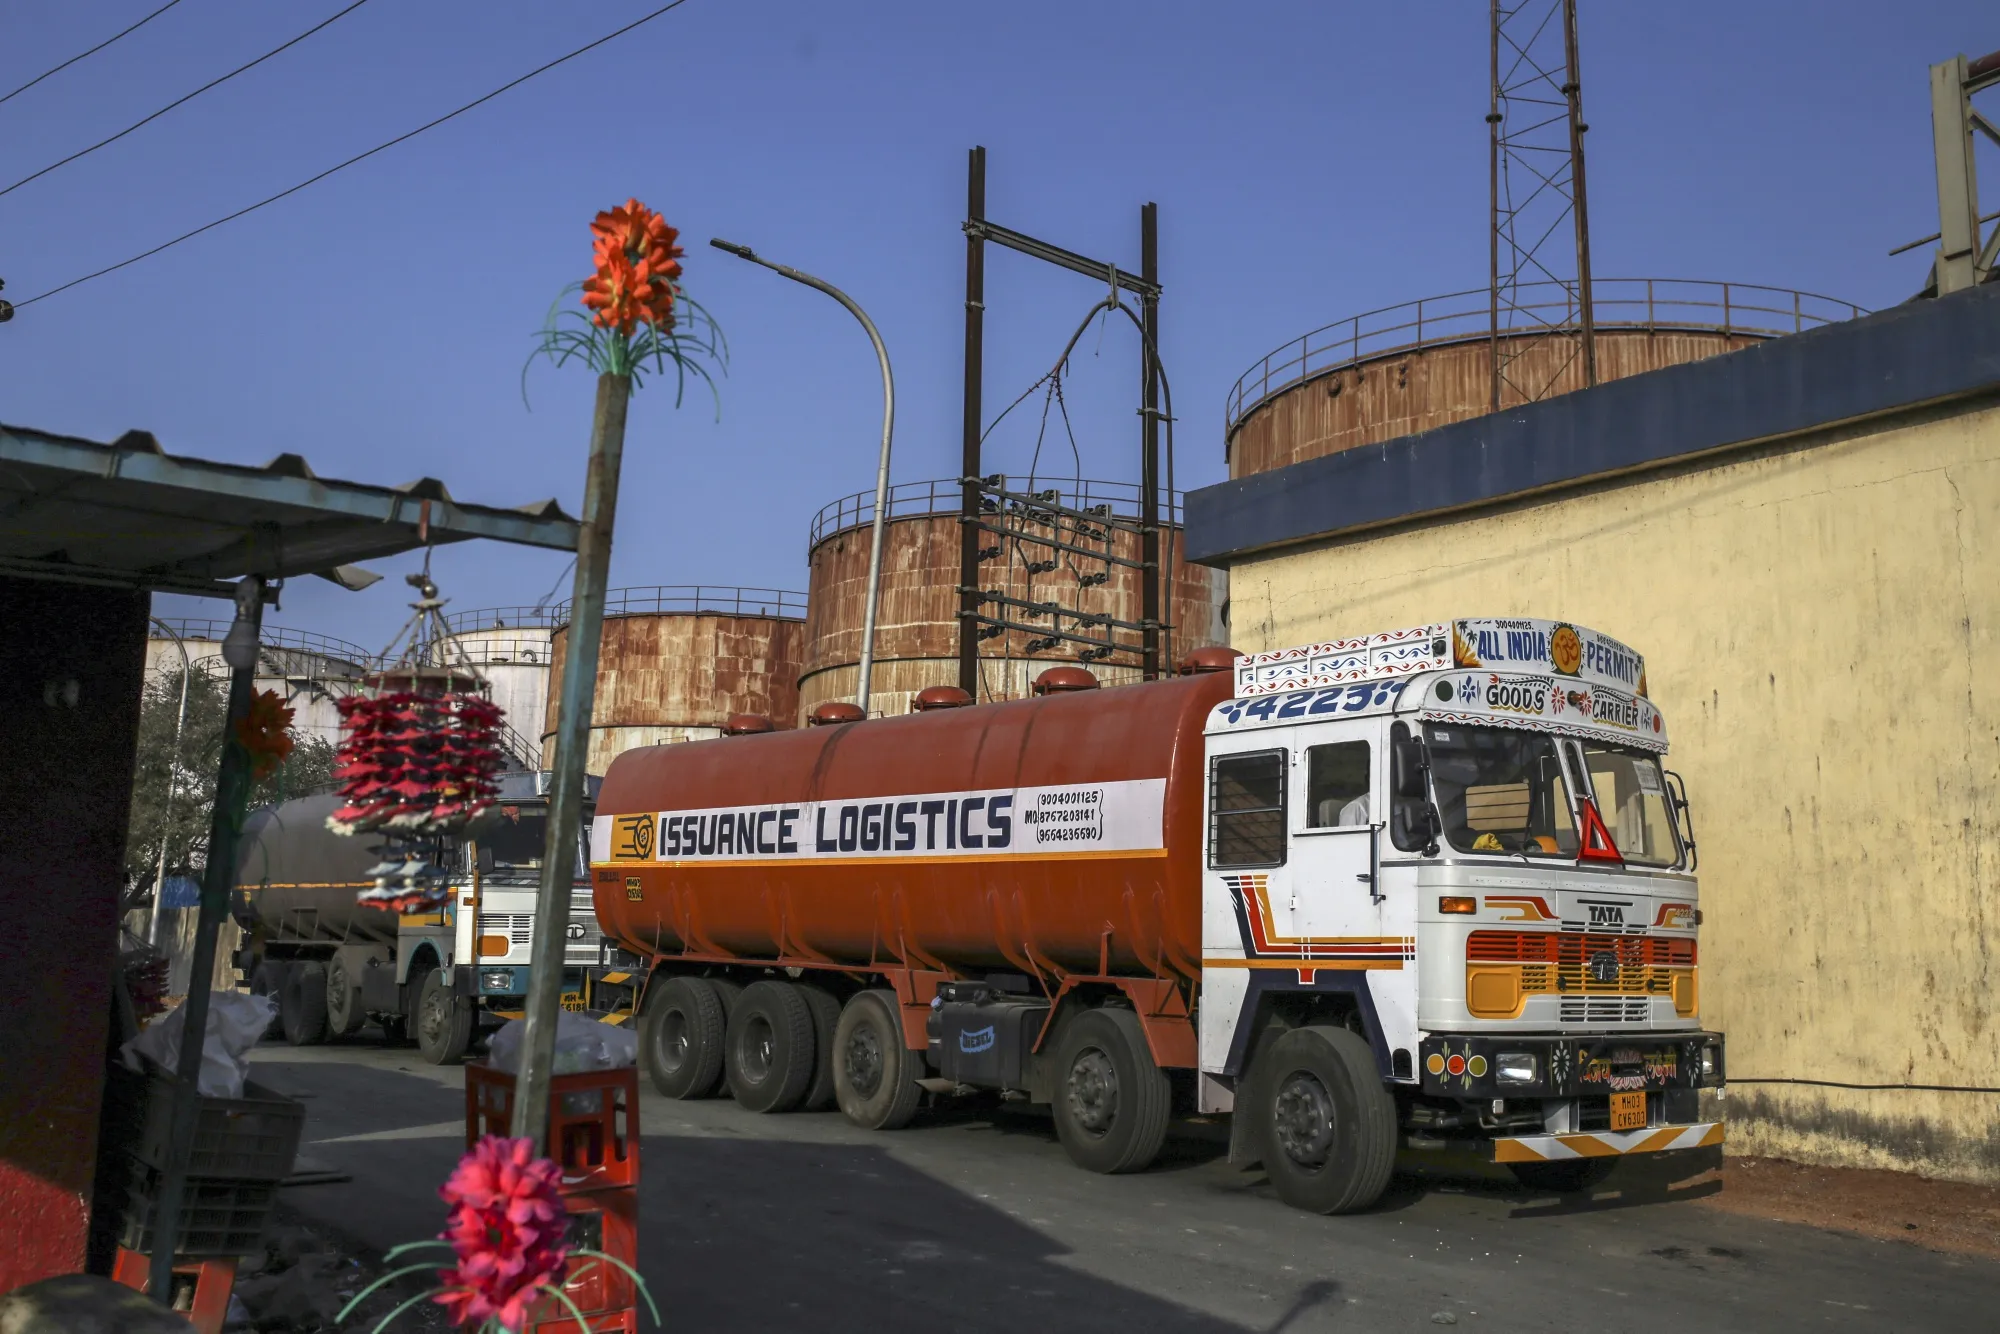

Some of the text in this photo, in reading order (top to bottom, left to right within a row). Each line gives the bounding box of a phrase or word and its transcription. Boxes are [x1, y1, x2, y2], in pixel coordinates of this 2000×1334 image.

[1477, 630, 1635, 685] ALL INDIA PERMIT
[1486, 684, 1639, 727] GOODS CARRIER
[1041, 791, 1098, 806] 9004001125
[1039, 808, 1095, 823] 8767203141
[660, 795, 1013, 856] ISSUANCE LOGISTICS
[1039, 827, 1097, 841] 9664236690
[1588, 906, 1624, 922] TATA
[1621, 1095, 1640, 1109] MH03
[1618, 1111, 1645, 1127] CV6303
